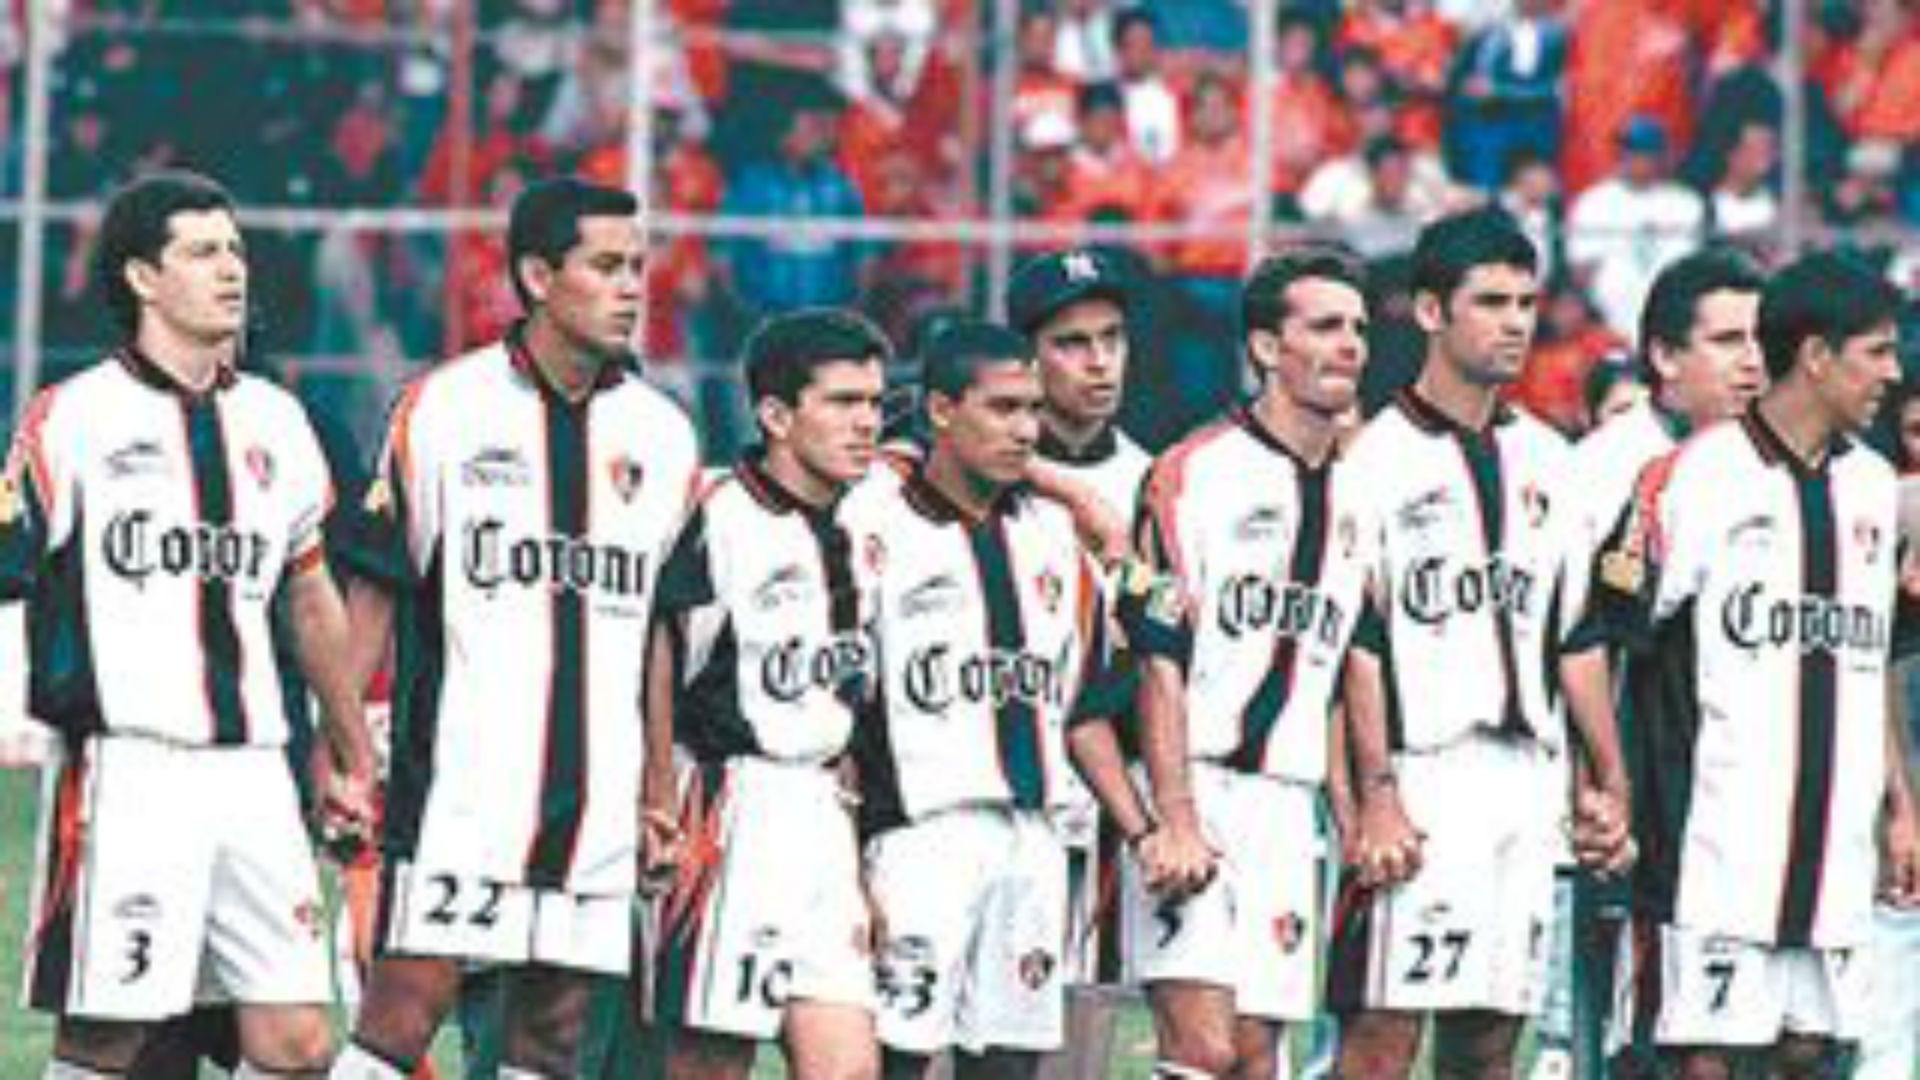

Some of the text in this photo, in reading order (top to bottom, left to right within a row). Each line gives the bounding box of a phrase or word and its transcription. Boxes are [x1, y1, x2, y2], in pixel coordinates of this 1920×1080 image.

[422, 874, 504, 929] 22
[118, 929, 151, 984] 3
[1403, 930, 1472, 983] 27
[1703, 961, 1736, 1012] 7
